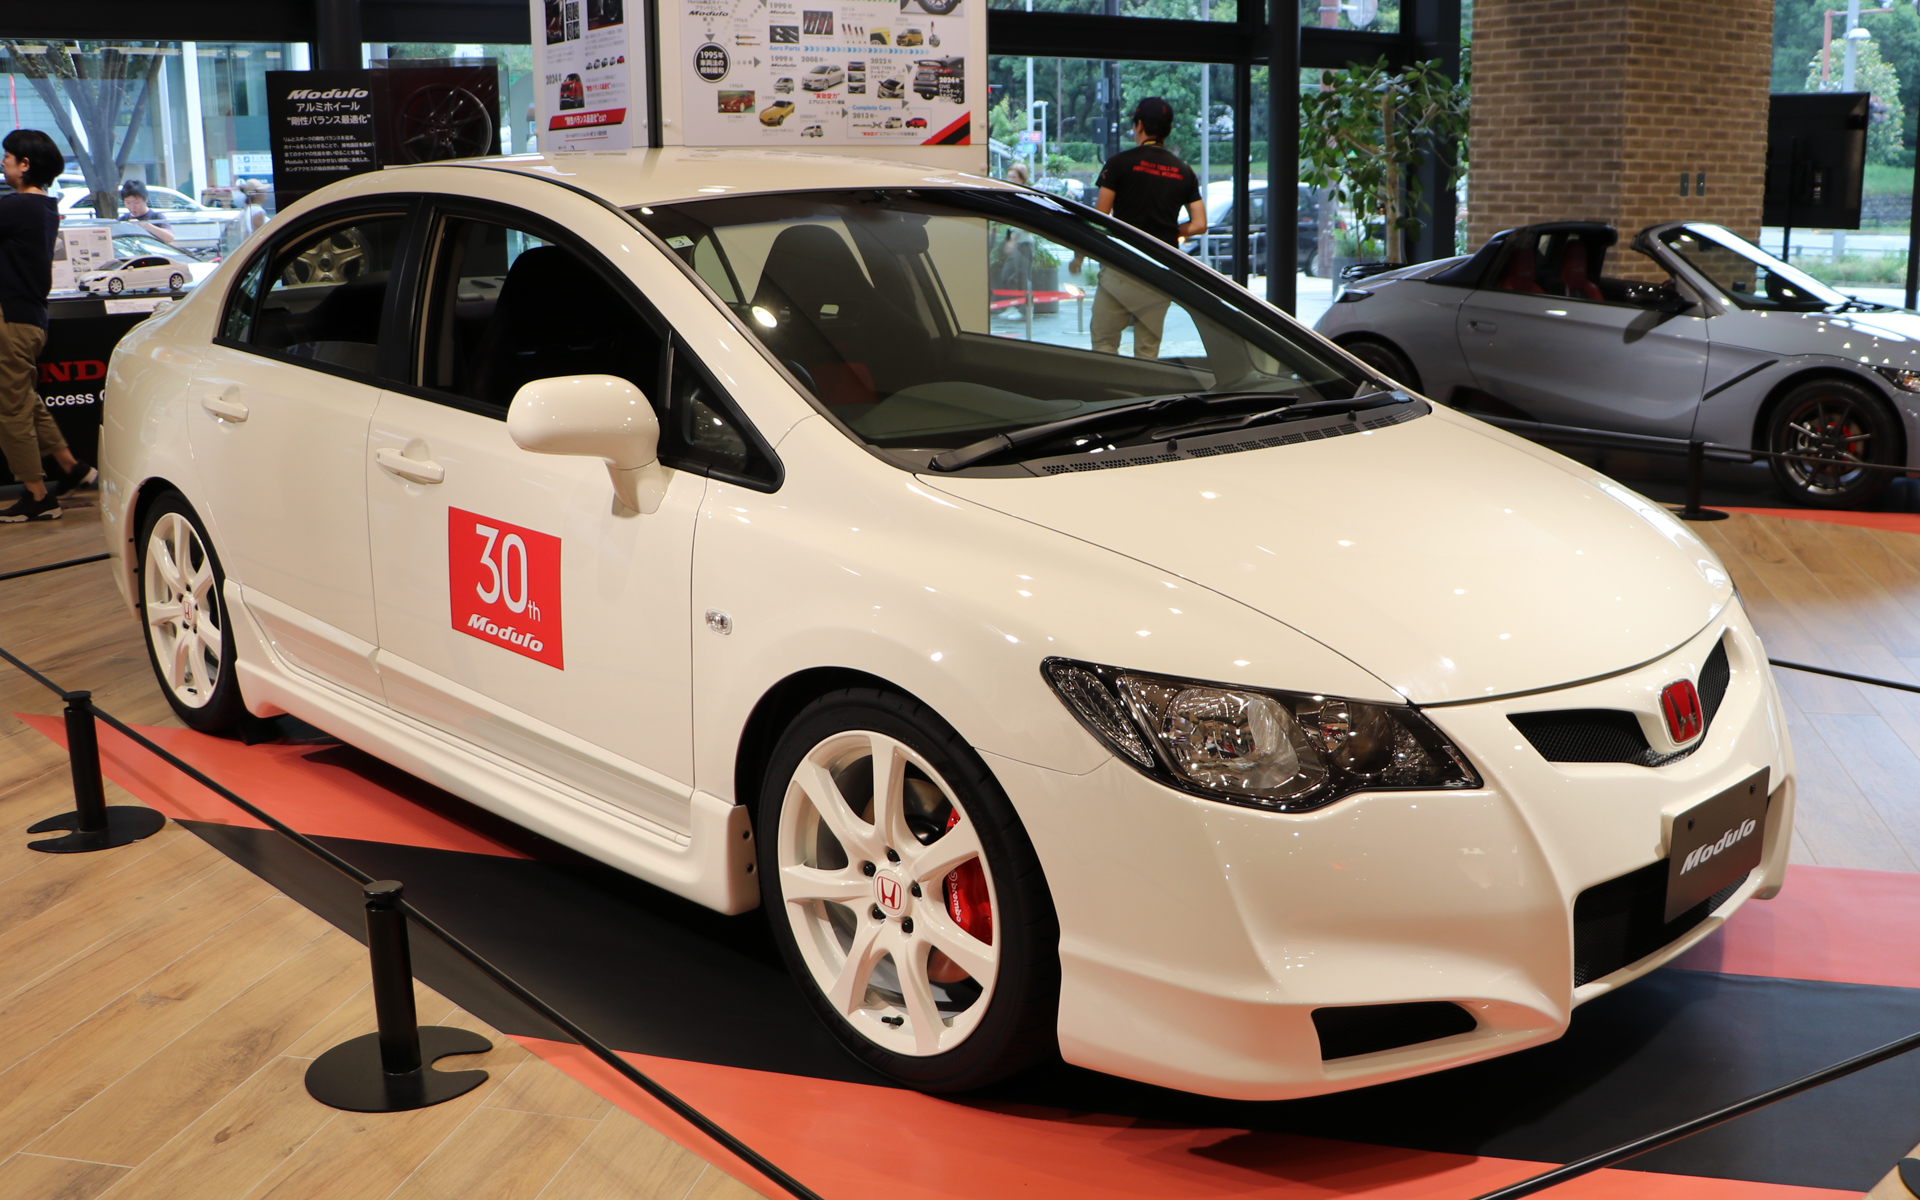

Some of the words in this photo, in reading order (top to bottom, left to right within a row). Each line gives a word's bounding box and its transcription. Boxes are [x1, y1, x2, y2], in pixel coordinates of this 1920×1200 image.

[700, 51, 724, 59] 1995年
[287, 88, 369, 100] Modulo
[296, 101, 360, 112] アルミホイール
[38, 393, 95, 407] ccess
[467, 613, 544, 652] Modulo
[1679, 818, 1756, 876] Modulo
[950, 882, 962, 923] brembo
